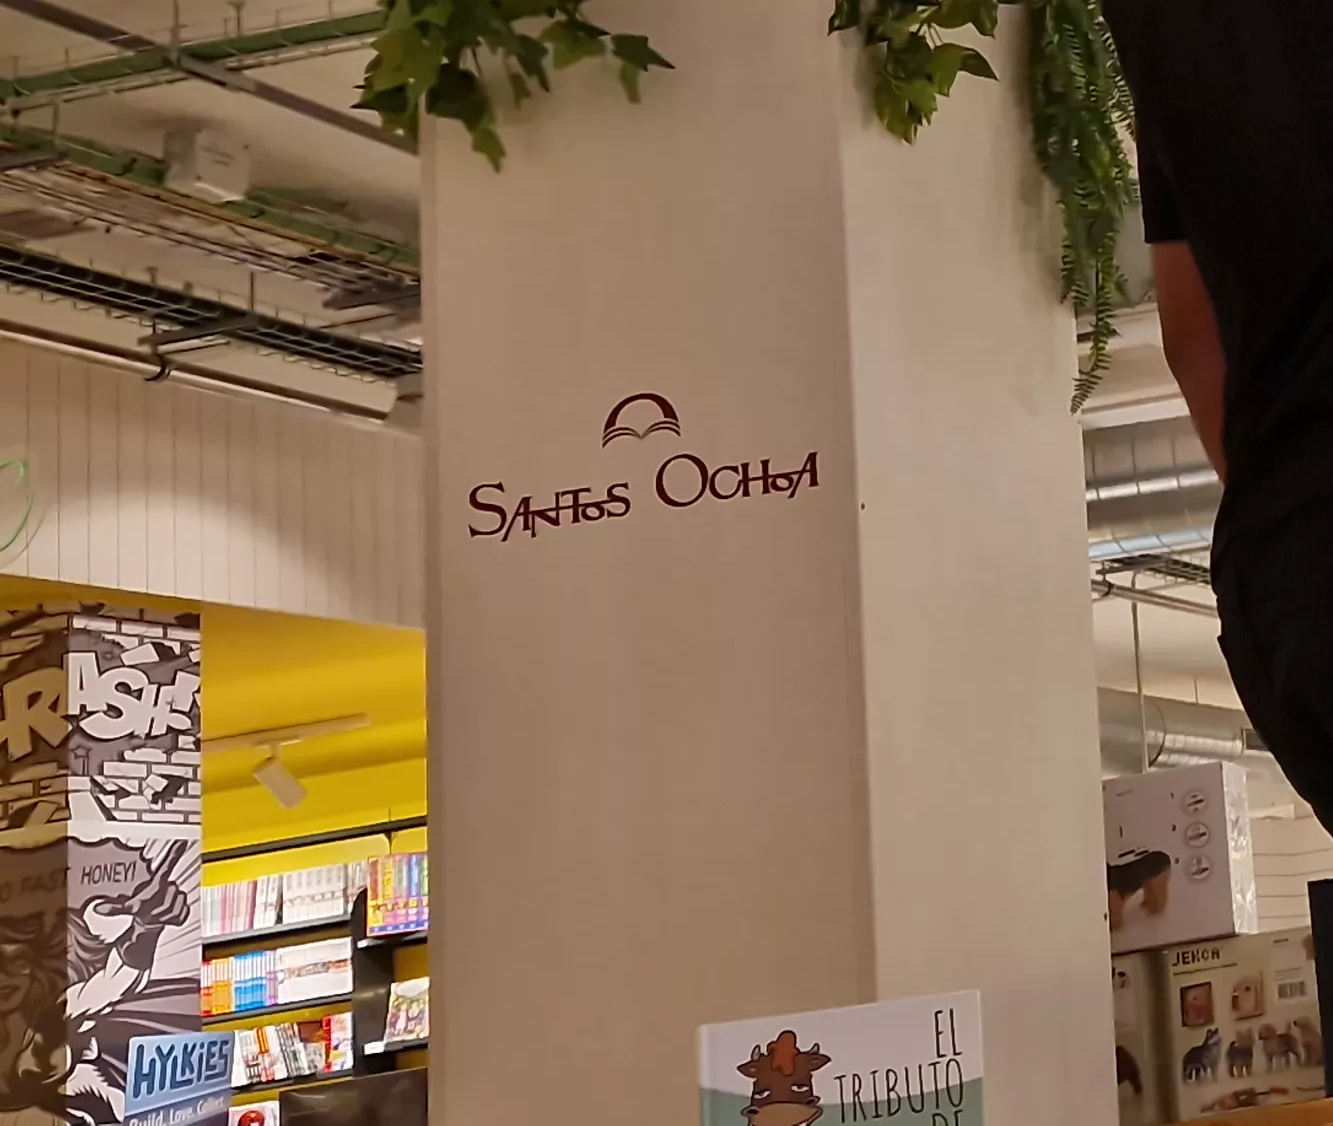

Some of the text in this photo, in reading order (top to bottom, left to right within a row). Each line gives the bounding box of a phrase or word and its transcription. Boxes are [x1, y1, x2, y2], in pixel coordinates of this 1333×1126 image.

[655, 451, 820, 509] OCHOA
[933, 1007, 963, 1059] EL
[833, 1058, 964, 1124] TRIBUTO
